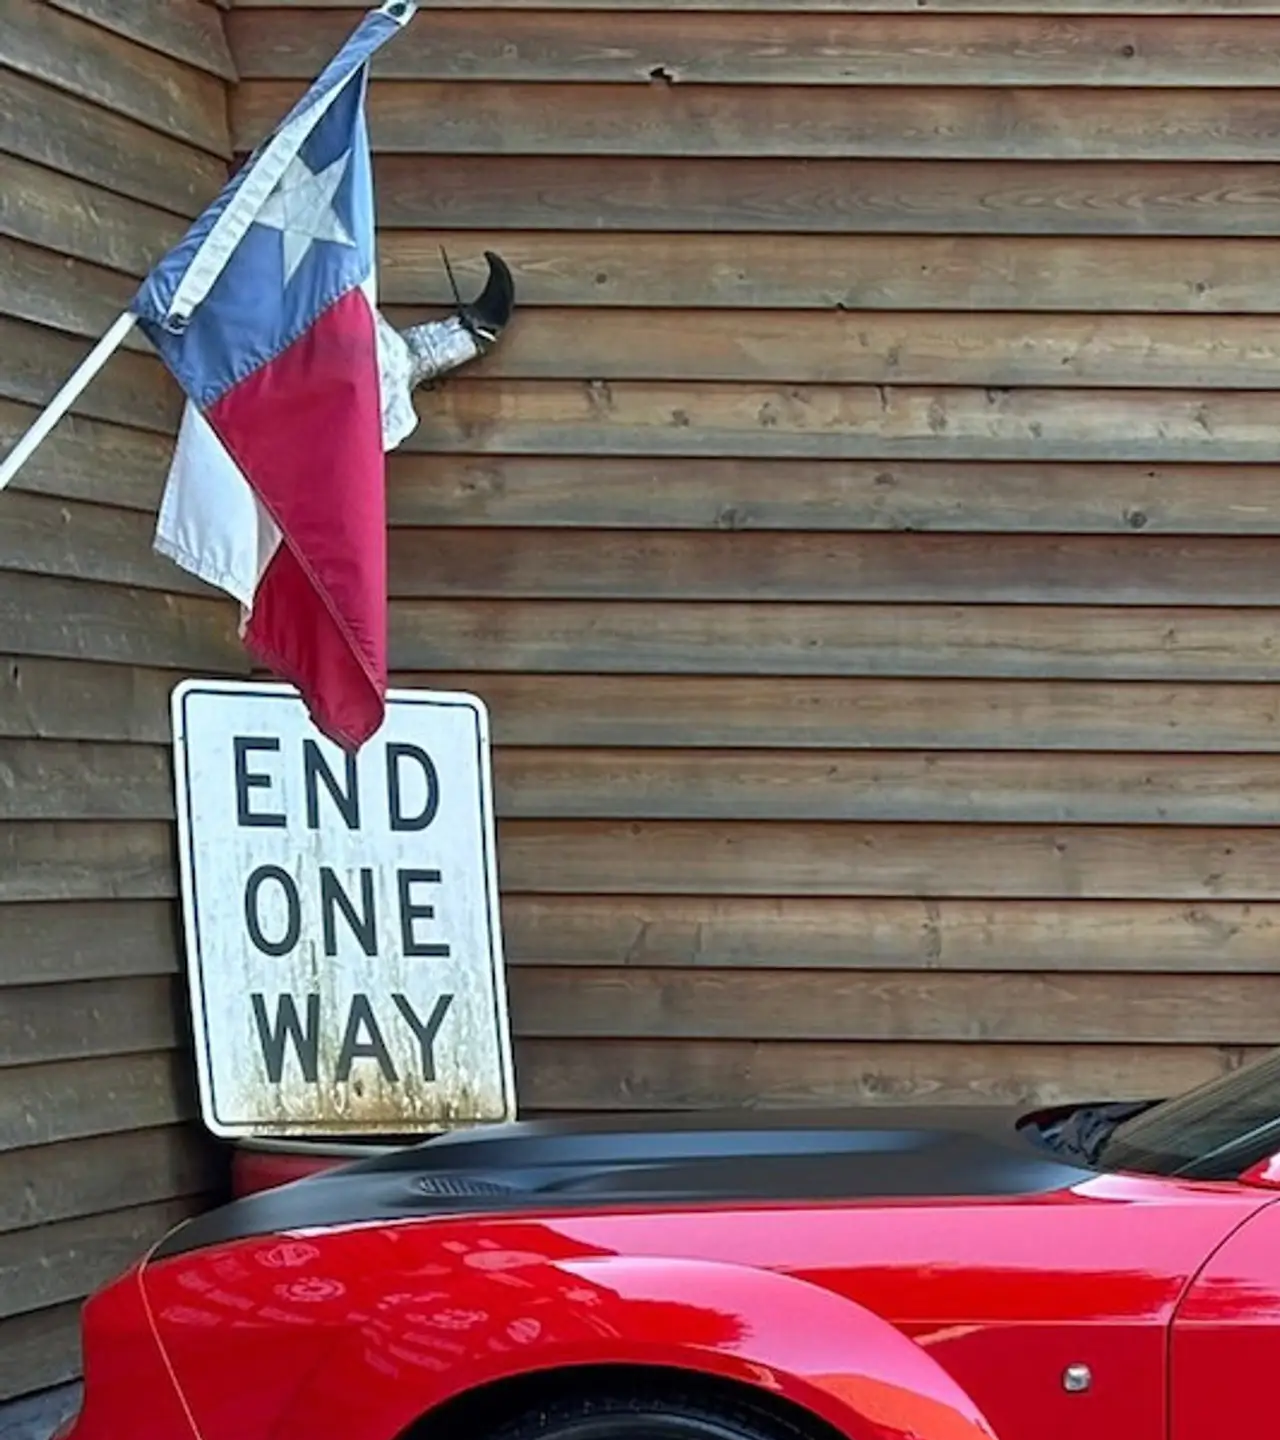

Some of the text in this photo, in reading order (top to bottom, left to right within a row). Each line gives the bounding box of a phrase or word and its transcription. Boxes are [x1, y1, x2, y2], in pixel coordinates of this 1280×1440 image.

[233, 736, 440, 832] END
[243, 864, 451, 958] ONE
[251, 992, 455, 1084] WAY
